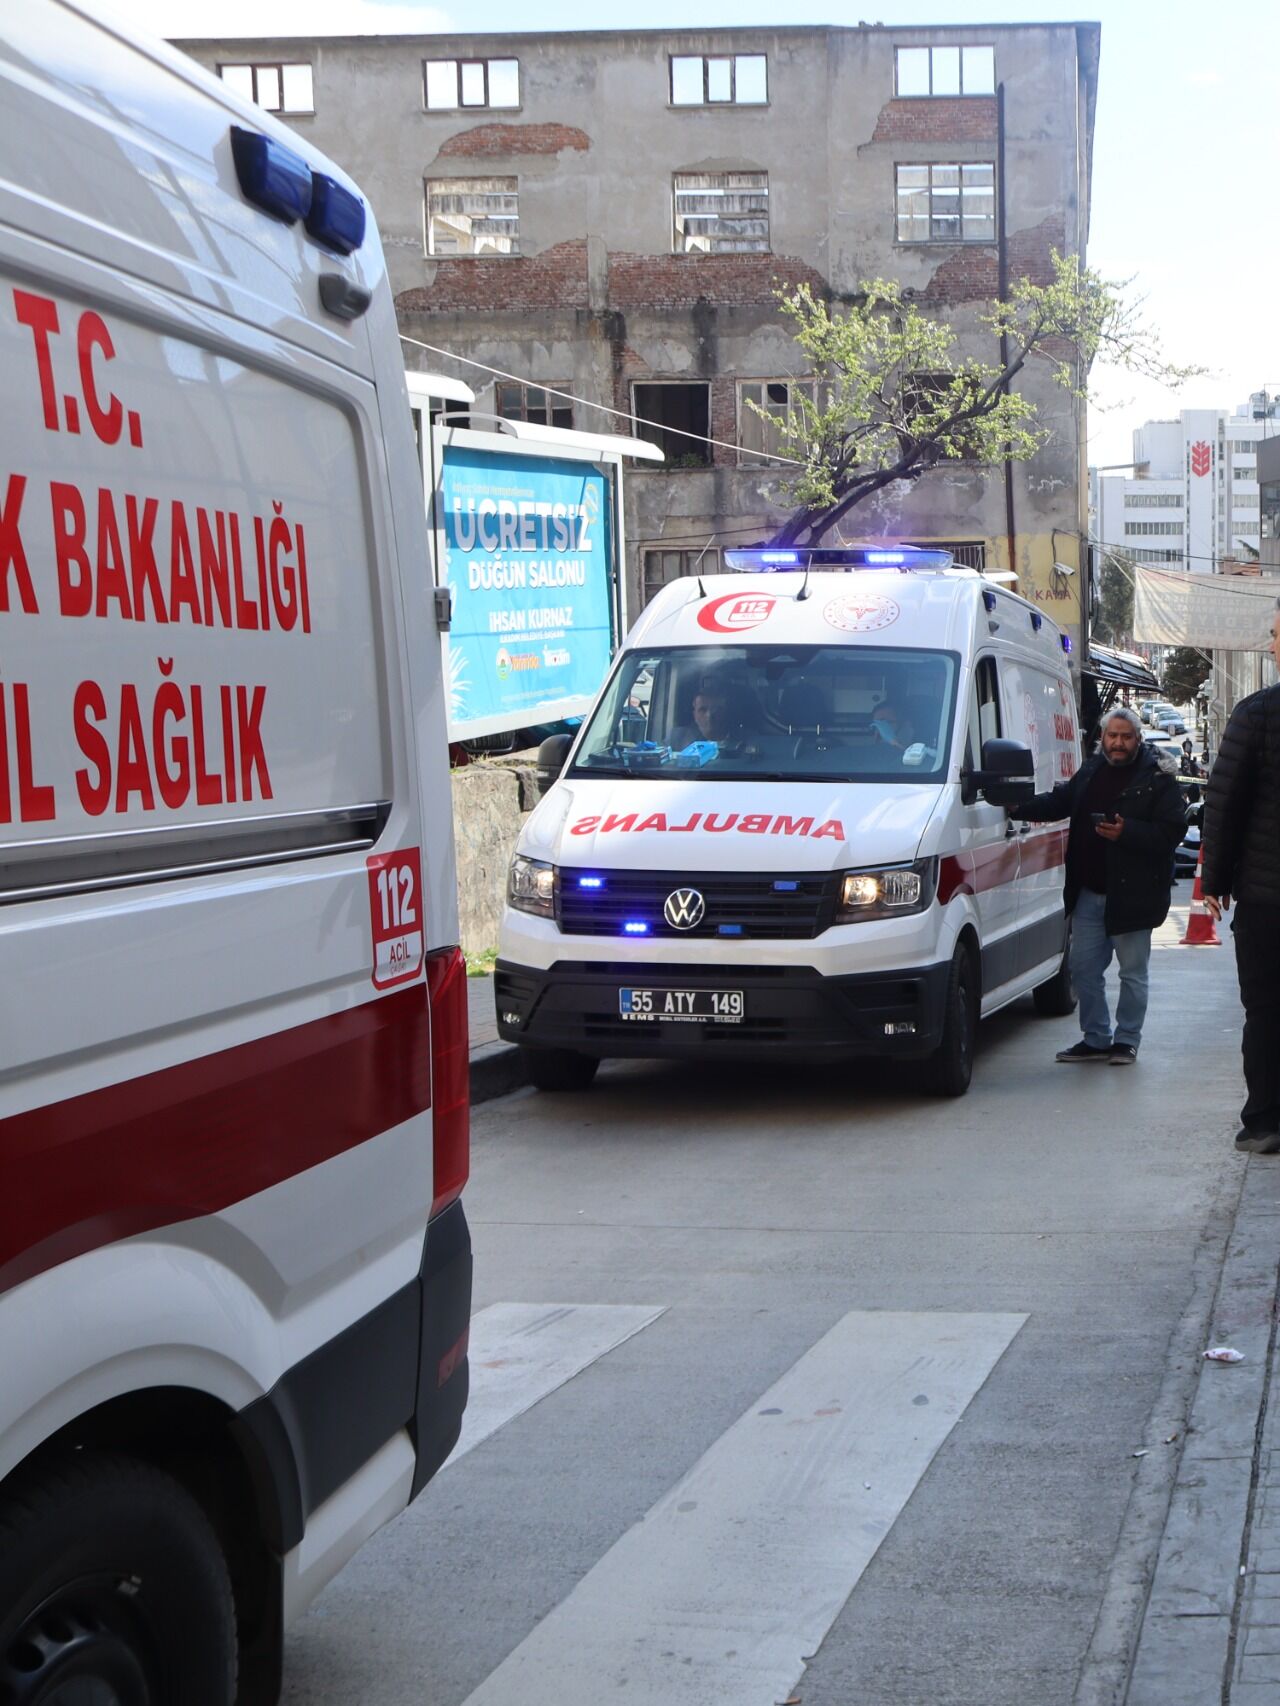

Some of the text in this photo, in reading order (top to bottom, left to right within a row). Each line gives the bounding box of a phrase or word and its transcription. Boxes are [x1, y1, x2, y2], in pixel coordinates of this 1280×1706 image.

[12, 288, 143, 448] T.C.
[453, 496, 593, 552] ÜCRETSİZ
[49, 480, 311, 633] BAKANLIĞI
[468, 554, 586, 591] DÜĞÜN SALONU
[488, 607, 574, 632] İHSAN KURNAZ
[739, 601, 769, 612] 112
[72, 656, 274, 817] SAĞLIK
[377, 864, 416, 930] 112
[389, 936, 411, 964] ACİL
[631, 991, 653, 1012] 55
[664, 992, 696, 1014] ATY
[711, 993, 741, 1014] 149
